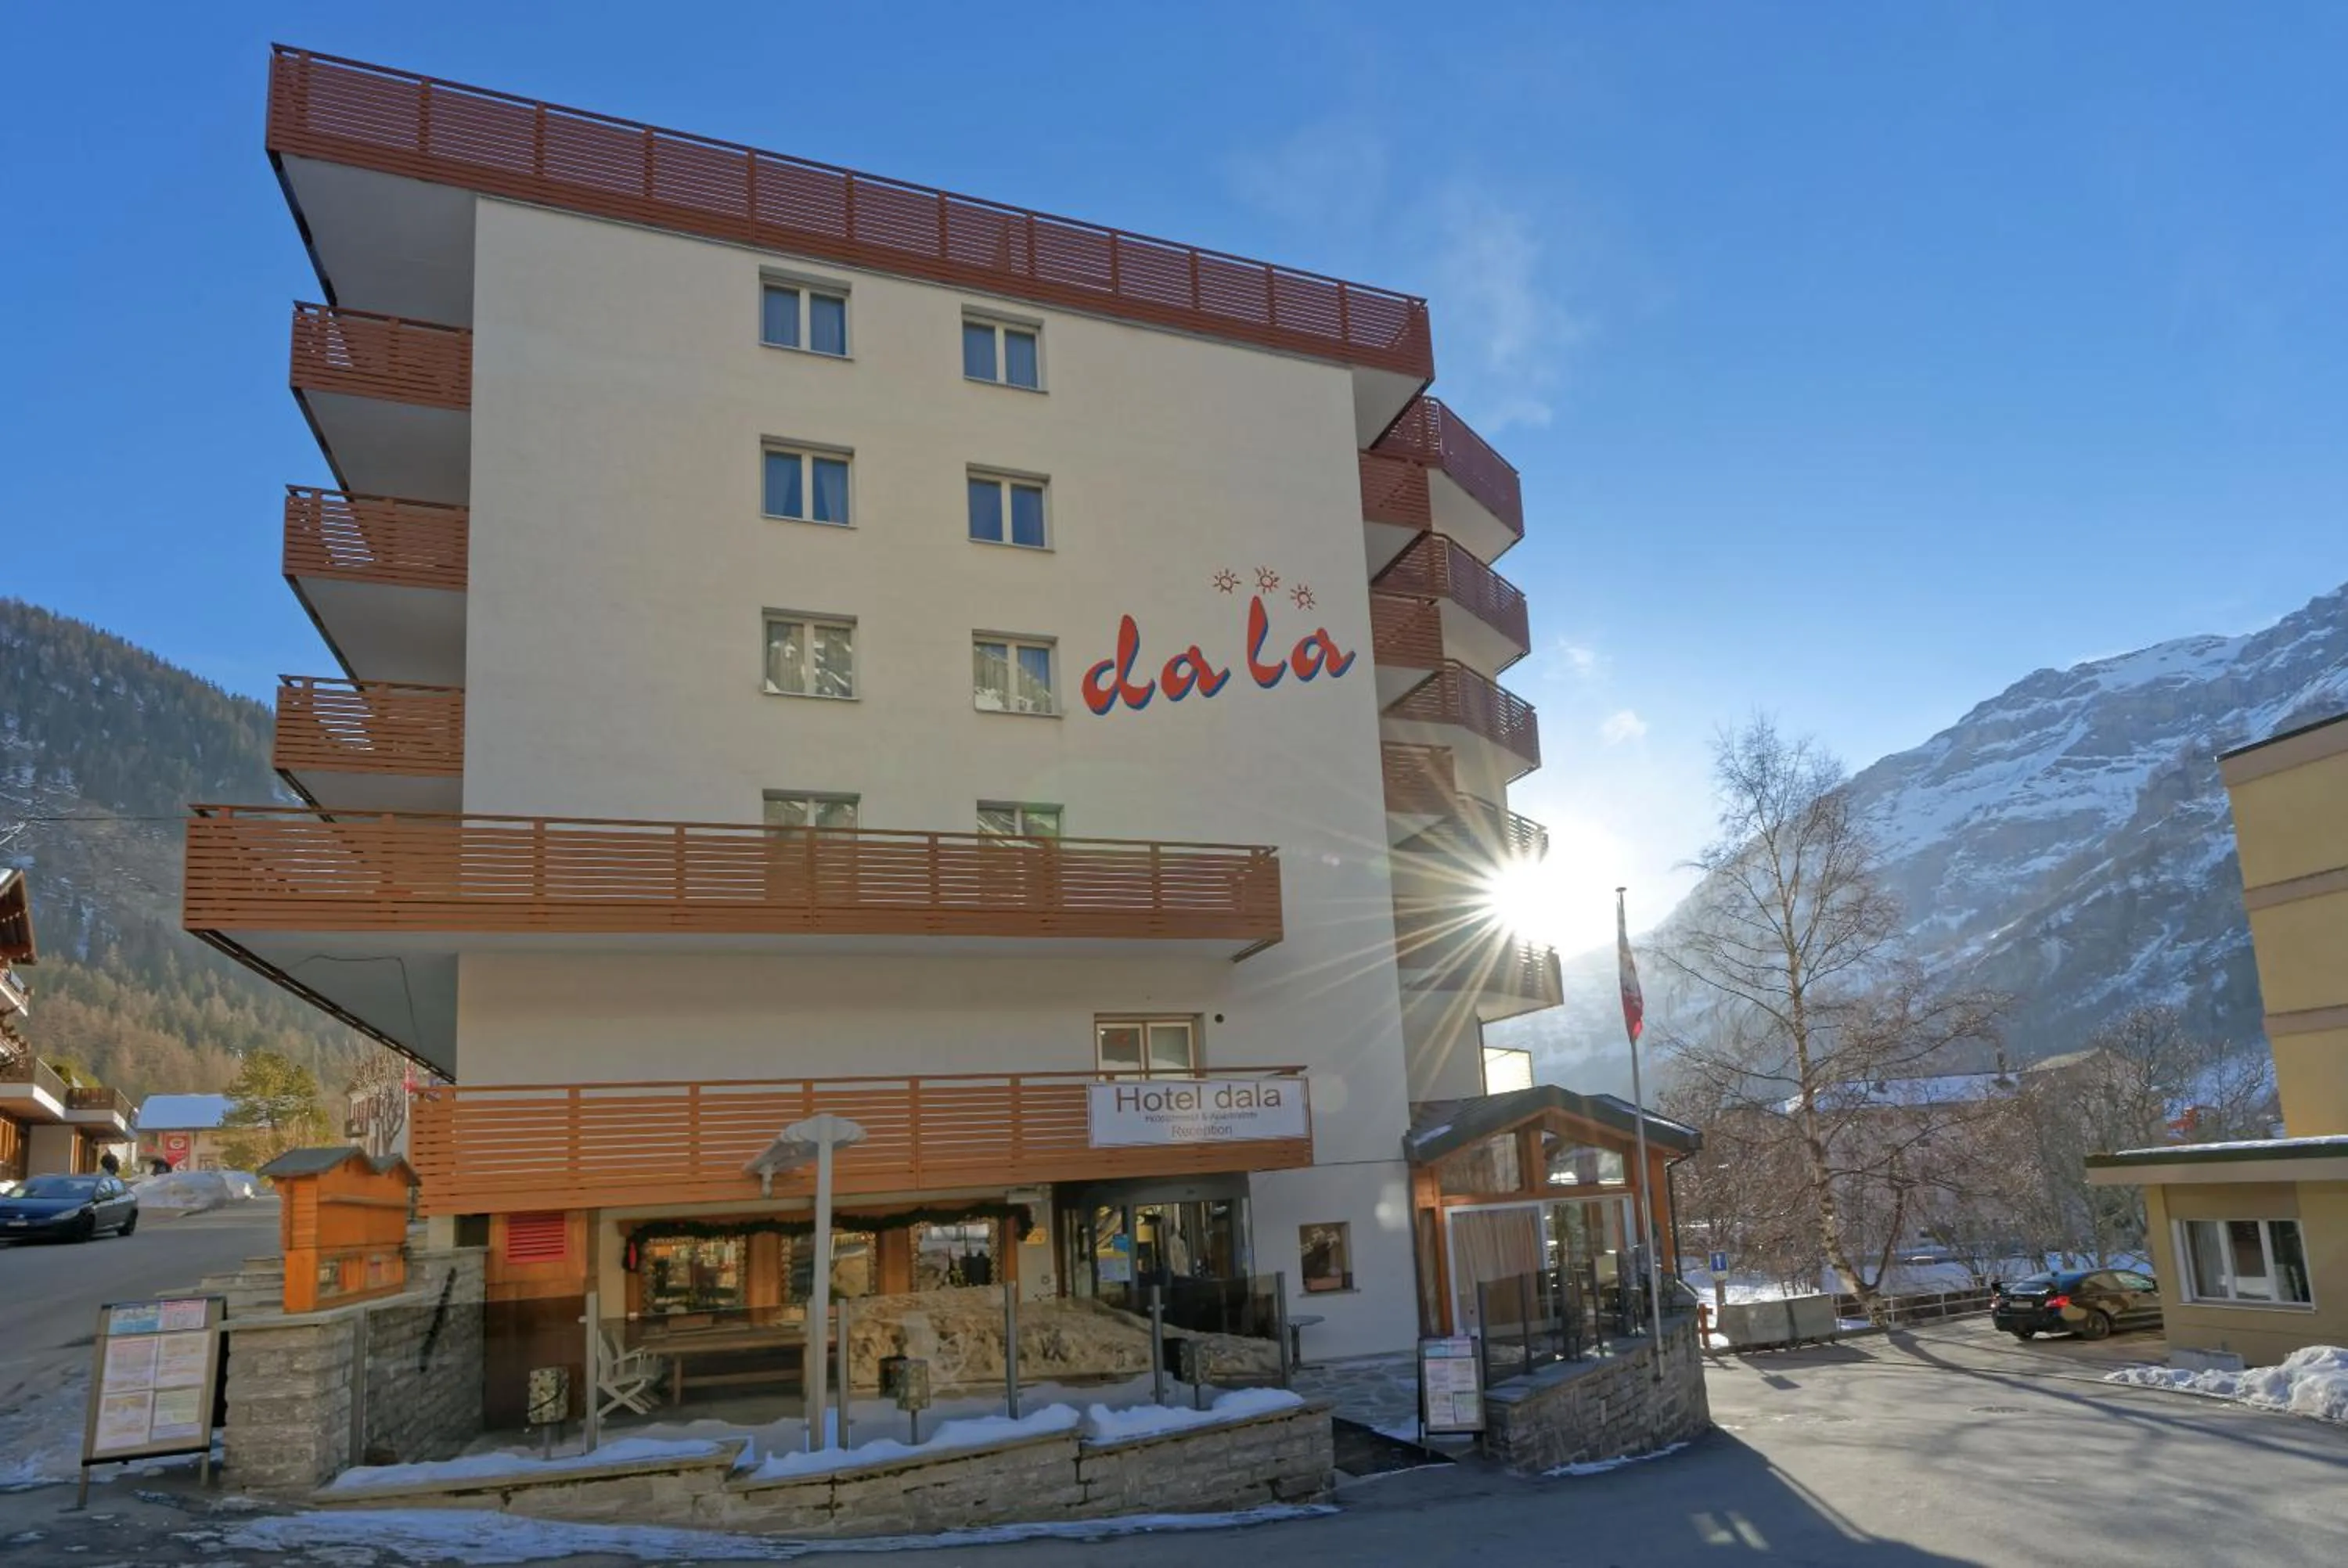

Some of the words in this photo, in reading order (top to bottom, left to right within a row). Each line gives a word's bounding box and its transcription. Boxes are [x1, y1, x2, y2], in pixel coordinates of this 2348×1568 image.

[1082, 595, 1356, 715] dala
[1116, 1085, 1201, 1112] Hotel
[1214, 1083, 1281, 1108] dala
[1172, 1124, 1232, 1138] Reception
